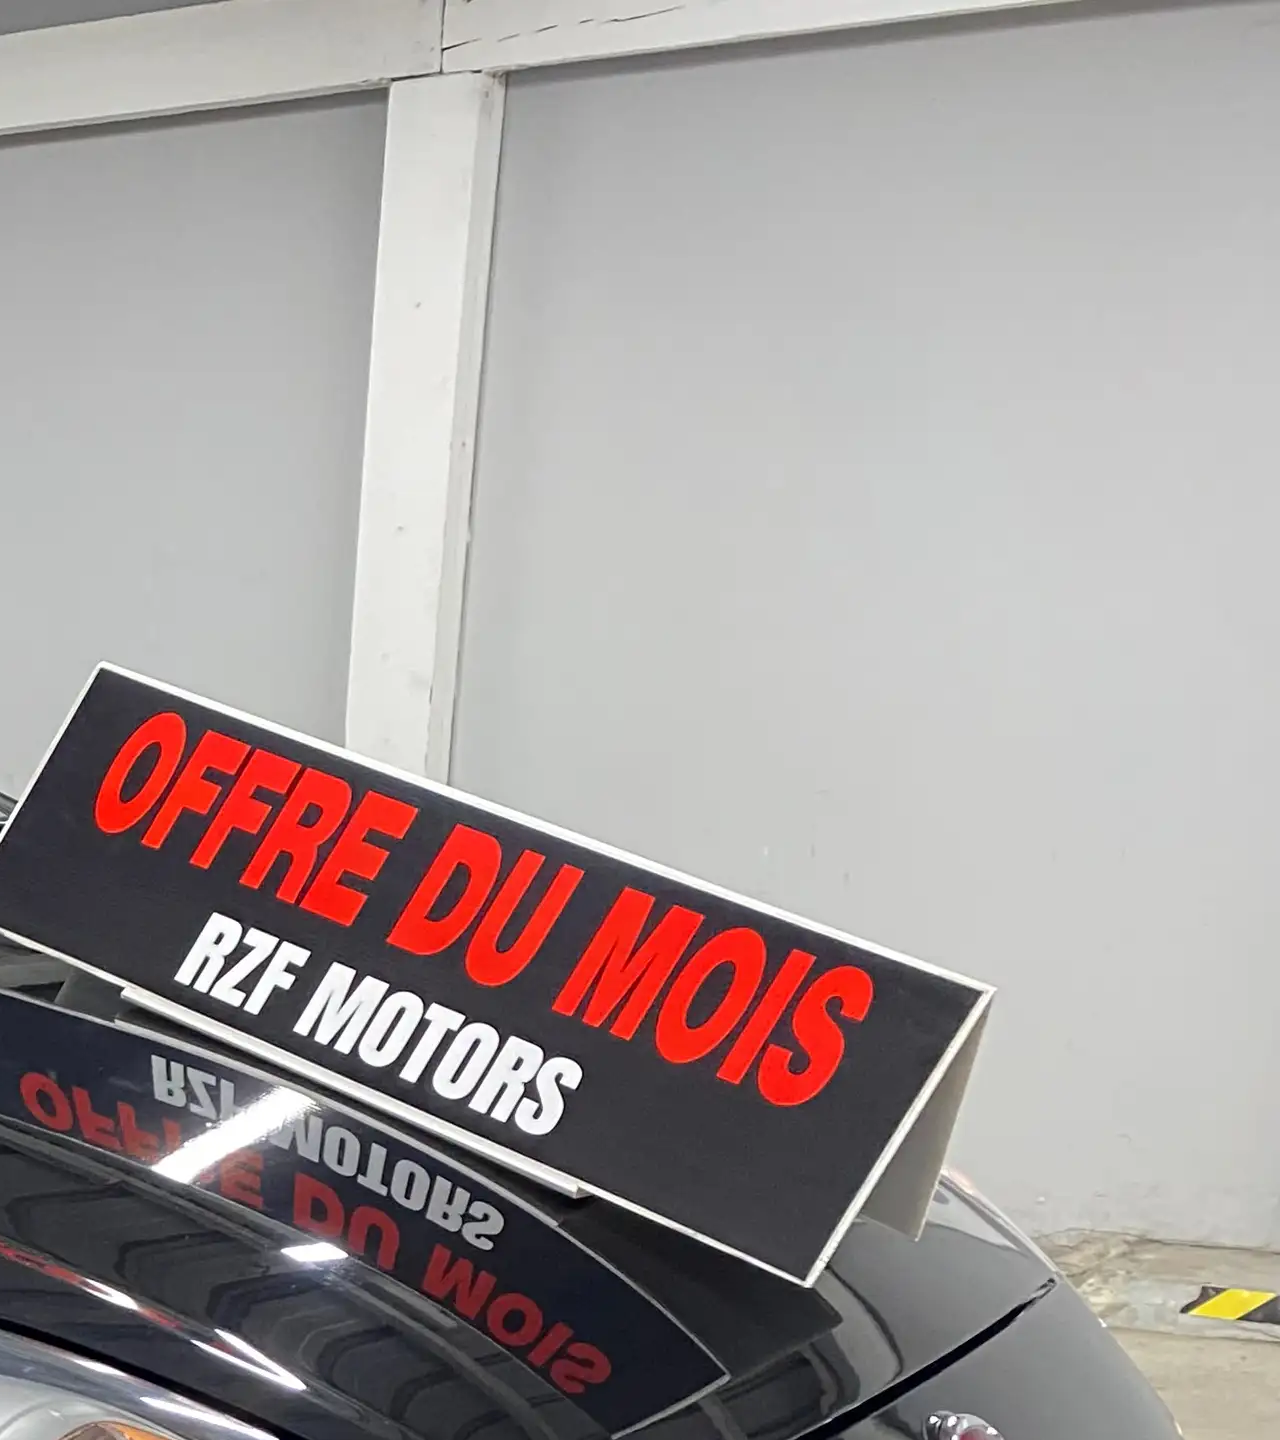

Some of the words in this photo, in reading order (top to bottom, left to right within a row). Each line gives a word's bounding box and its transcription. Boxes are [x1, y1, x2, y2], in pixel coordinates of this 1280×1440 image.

[92, 711, 419, 928] OFFRE
[385, 822, 585, 989] DU
[551, 885, 876, 1108] MOIS
[173, 911, 304, 1017] RZF
[292, 961, 584, 1137] MOTORS
